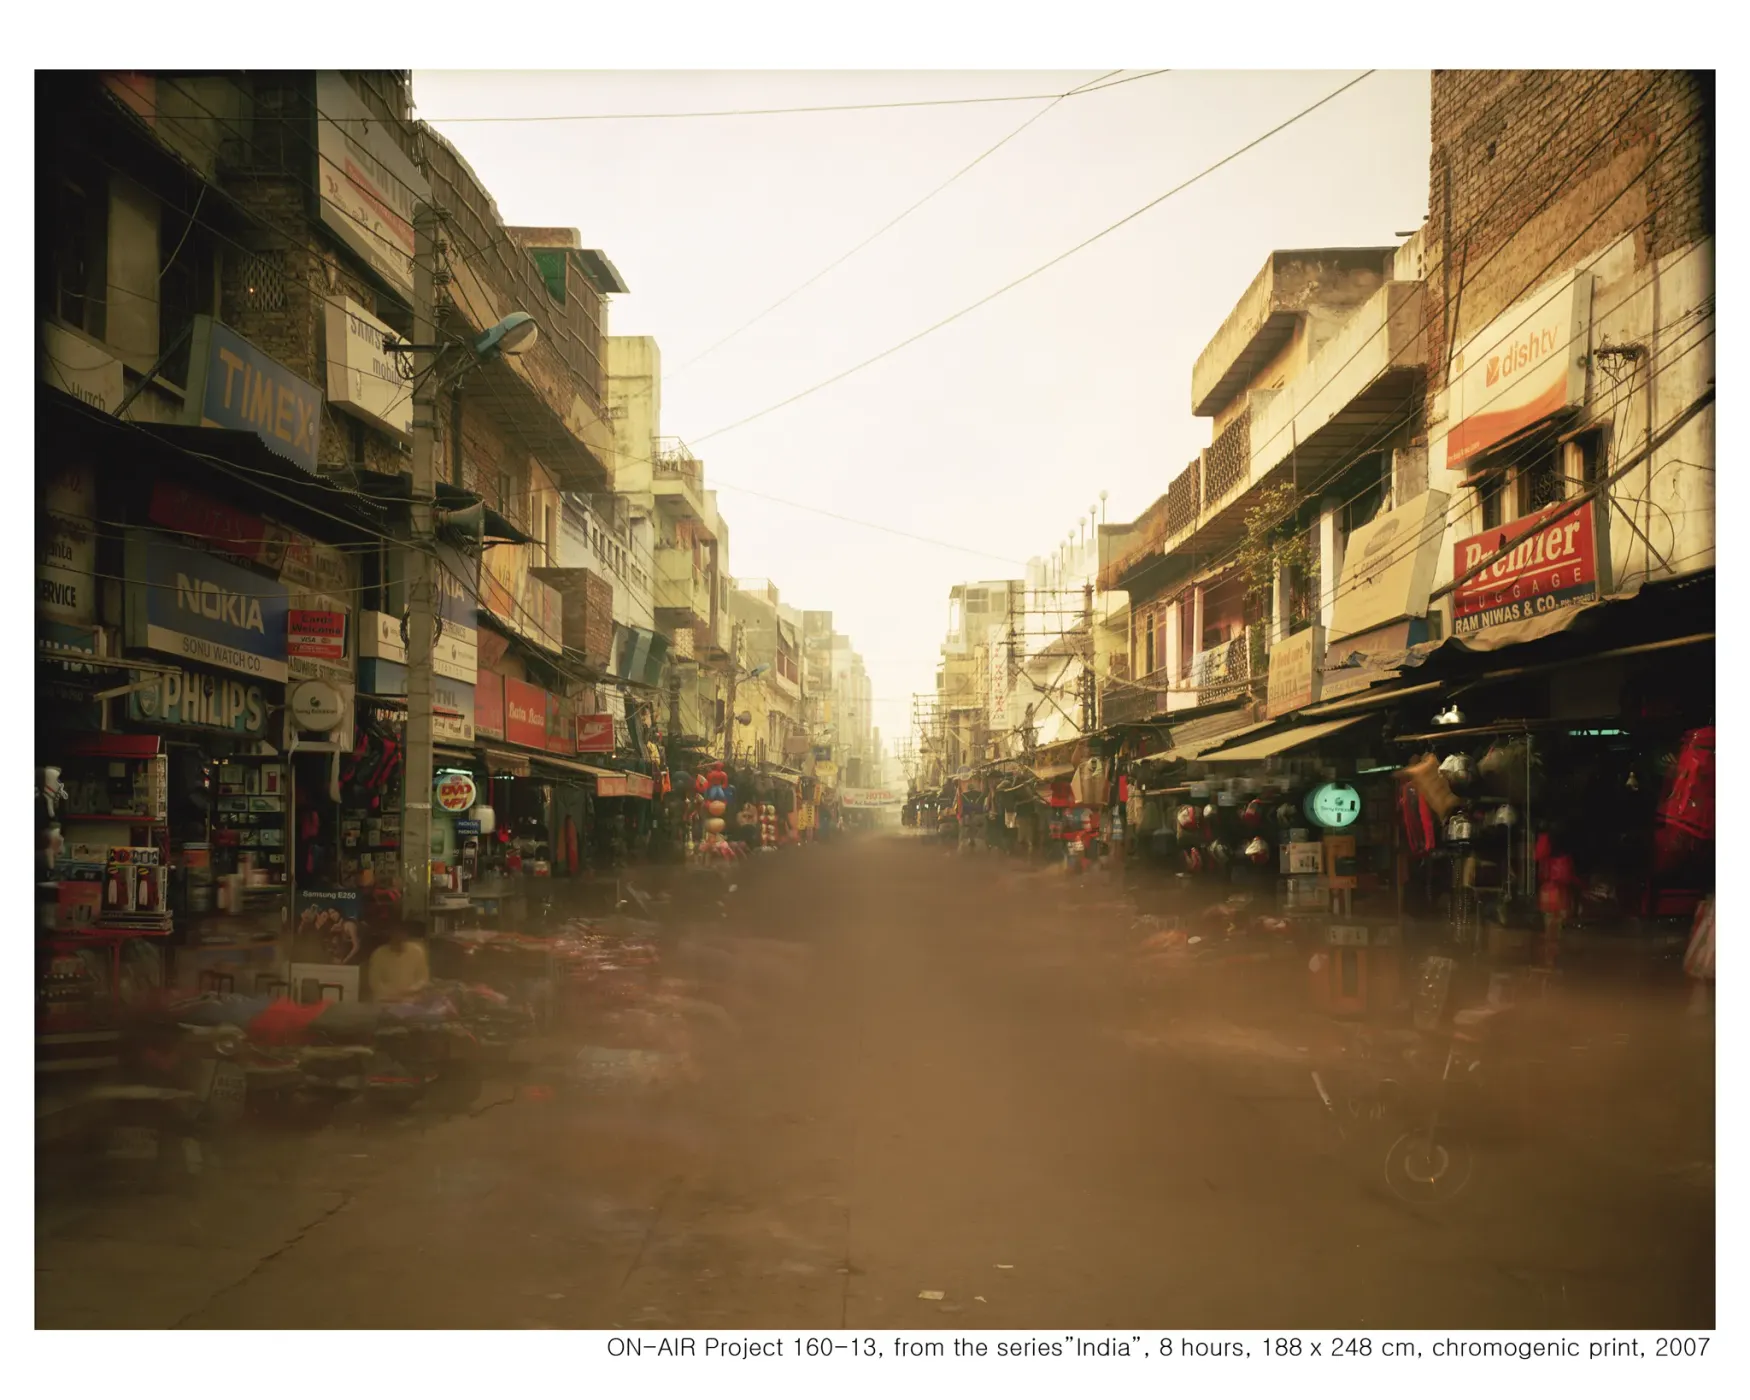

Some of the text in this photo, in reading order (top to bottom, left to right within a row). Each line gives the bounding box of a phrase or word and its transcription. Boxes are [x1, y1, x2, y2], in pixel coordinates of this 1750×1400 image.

[1502, 326, 1558, 378] dishtv
[220, 346, 310, 454] TIMEX
[1463, 520, 1581, 587] Premier
[42, 580, 76, 607] ERVICE
[176, 572, 265, 636] NOKIA
[1464, 567, 1581, 612] LUGGAGE
[292, 624, 341, 635] Welcome
[1455, 615, 1479, 634] RAM
[1482, 605, 1519, 628] NIWAS
[1524, 601, 1533, 616] &
[1537, 595, 1560, 613] CO.
[183, 636, 210, 658] SONU
[214, 645, 246, 668] WATCH
[161, 667, 261, 732] PHILIPS
[303, 890, 356, 900] Samsung E250
